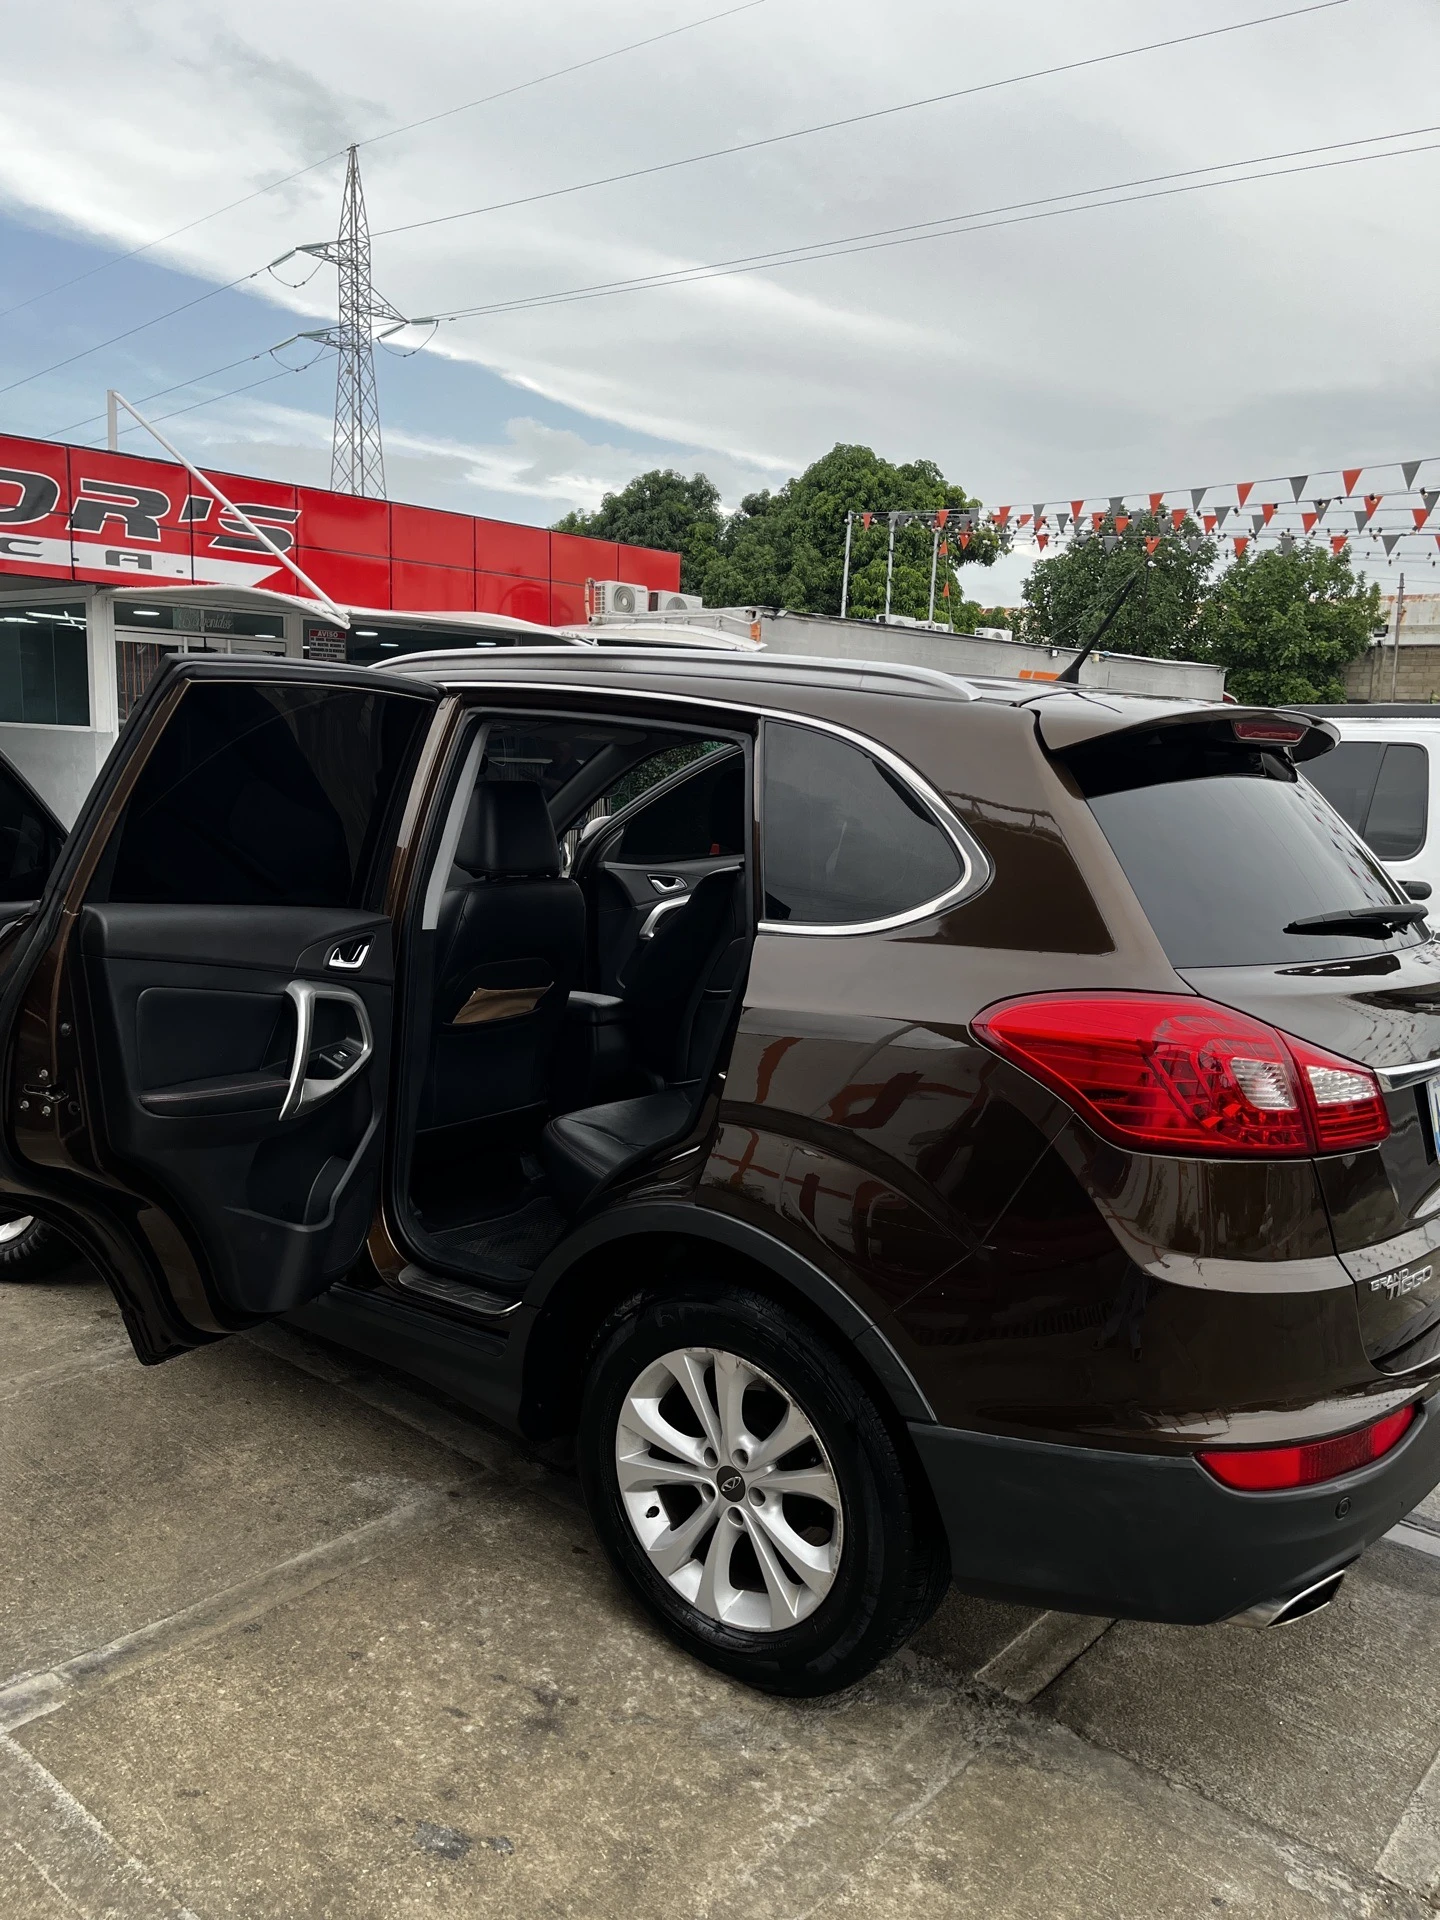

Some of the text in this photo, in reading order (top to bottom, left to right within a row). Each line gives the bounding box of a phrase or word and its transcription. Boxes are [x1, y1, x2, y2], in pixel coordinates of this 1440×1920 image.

[317, 630, 338, 638] AVISO
[1370, 1268, 1409, 1292] GRAND
[1386, 1264, 1433, 1301] TIGGO
